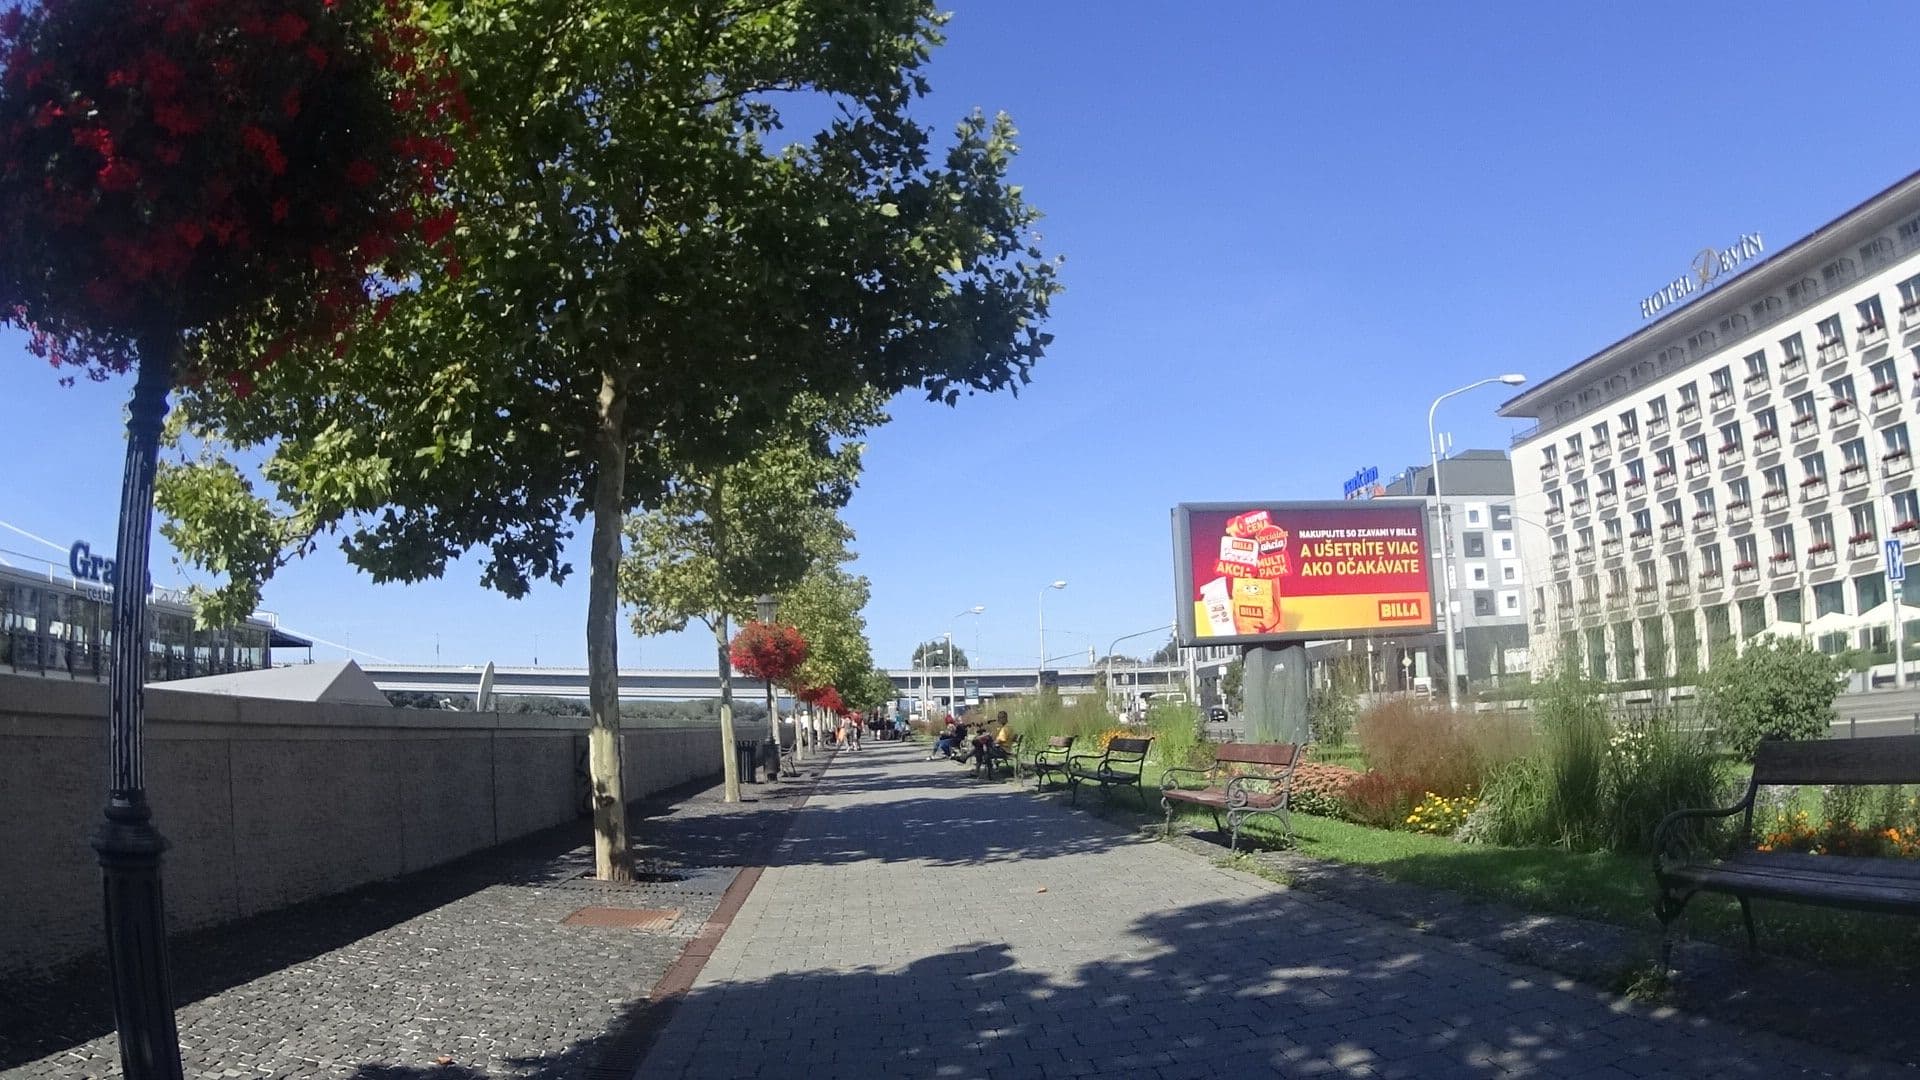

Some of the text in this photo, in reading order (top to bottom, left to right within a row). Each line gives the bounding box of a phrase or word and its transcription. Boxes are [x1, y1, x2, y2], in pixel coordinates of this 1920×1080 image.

[1640, 273, 1696, 319] HOTEL
[1245, 511, 1268, 523] SUPER
[1299, 530, 1345, 538] NAKUPUJTE
[1346, 529, 1357, 538] SO
[1390, 528, 1396, 536] V
[1396, 528, 1417, 536] BILLE
[1233, 541, 1253, 551] BILLA
[1261, 540, 1284, 551] akcia
[1300, 538, 1419, 558] A UŠETRÍTE VIAC
[1257, 554, 1285, 568] MULTI
[1301, 556, 1419, 577] AKO OČAKÁVATE
[1259, 564, 1288, 577] PACK
[1240, 606, 1263, 617] BILLA
[1381, 602, 1419, 618] BILLA
